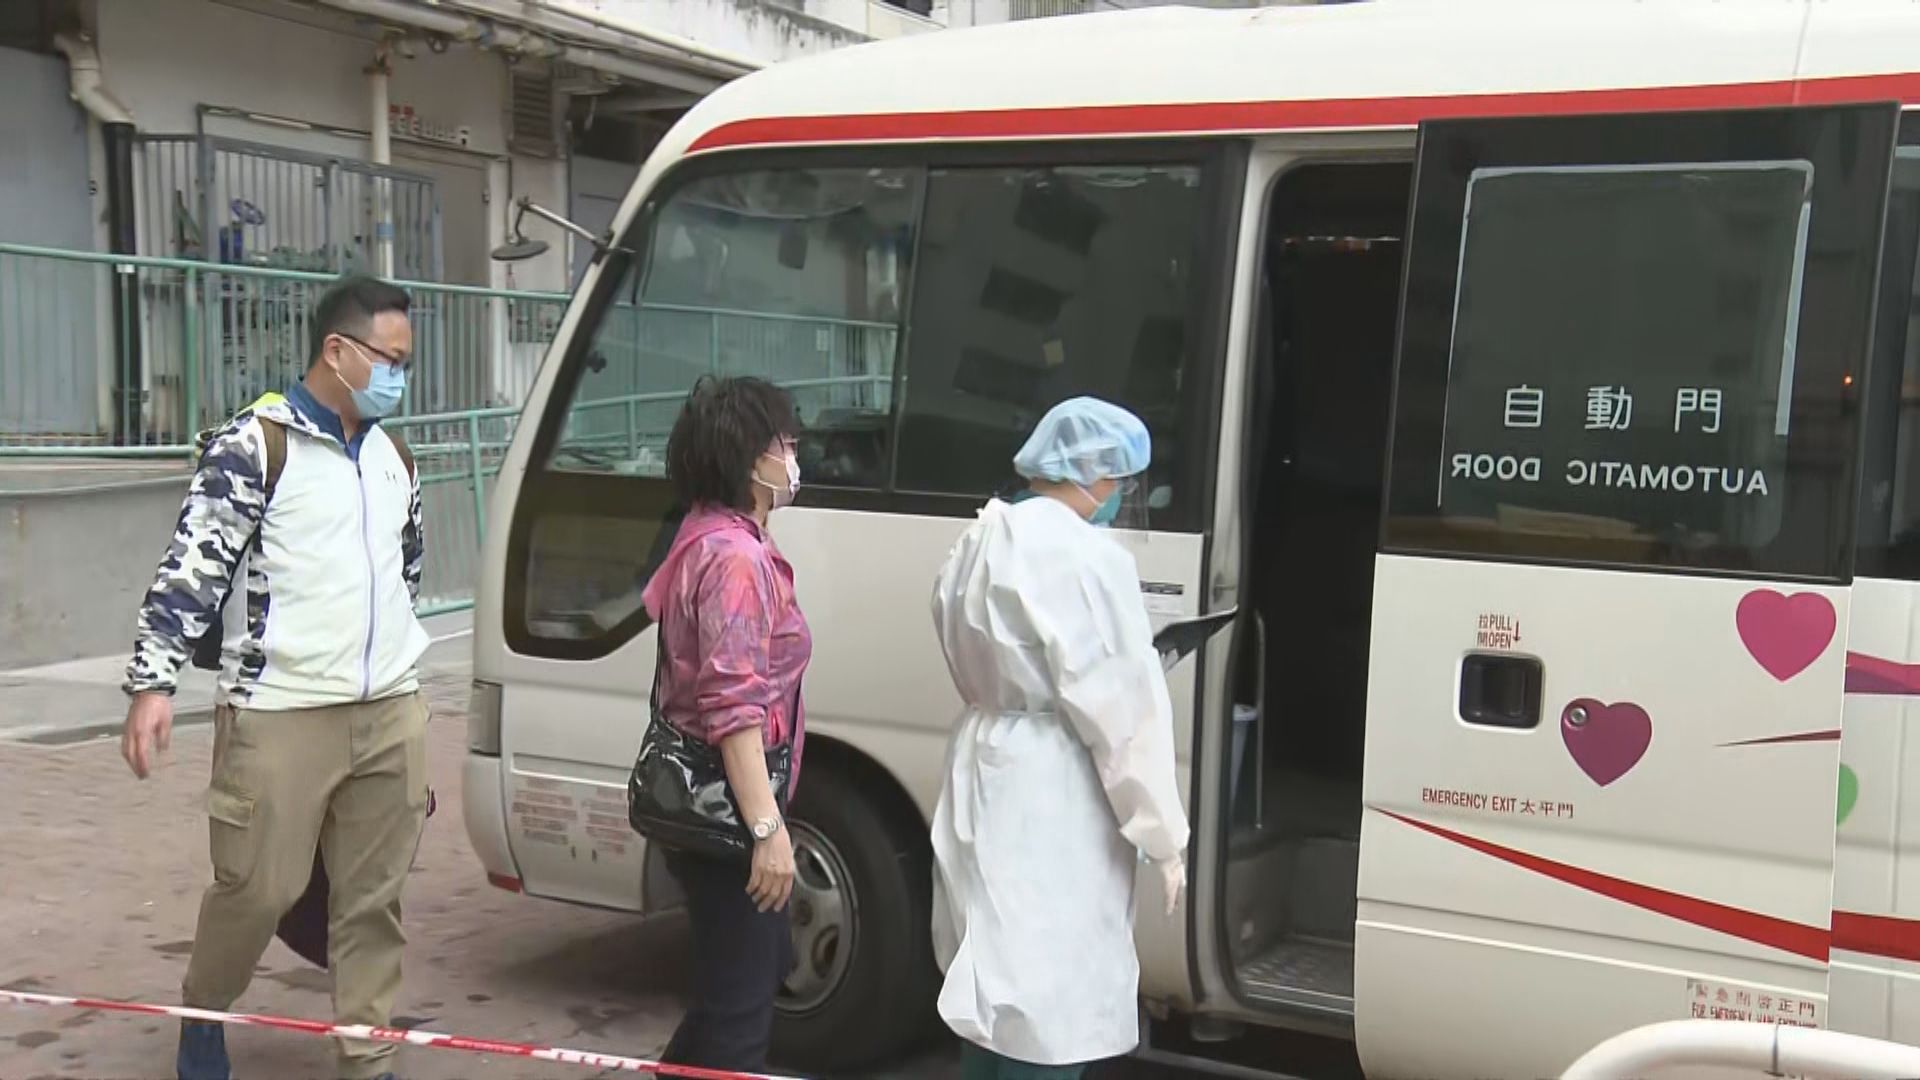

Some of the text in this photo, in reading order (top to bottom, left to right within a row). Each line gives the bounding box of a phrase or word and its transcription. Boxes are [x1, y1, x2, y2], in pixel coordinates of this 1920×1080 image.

[1504, 384, 1722, 433] 自動門
[1489, 614, 1512, 631] PULL
[1489, 631, 1511, 649] OPEN
[1422, 787, 1574, 818] EMERGENCY EXIT 太平門
